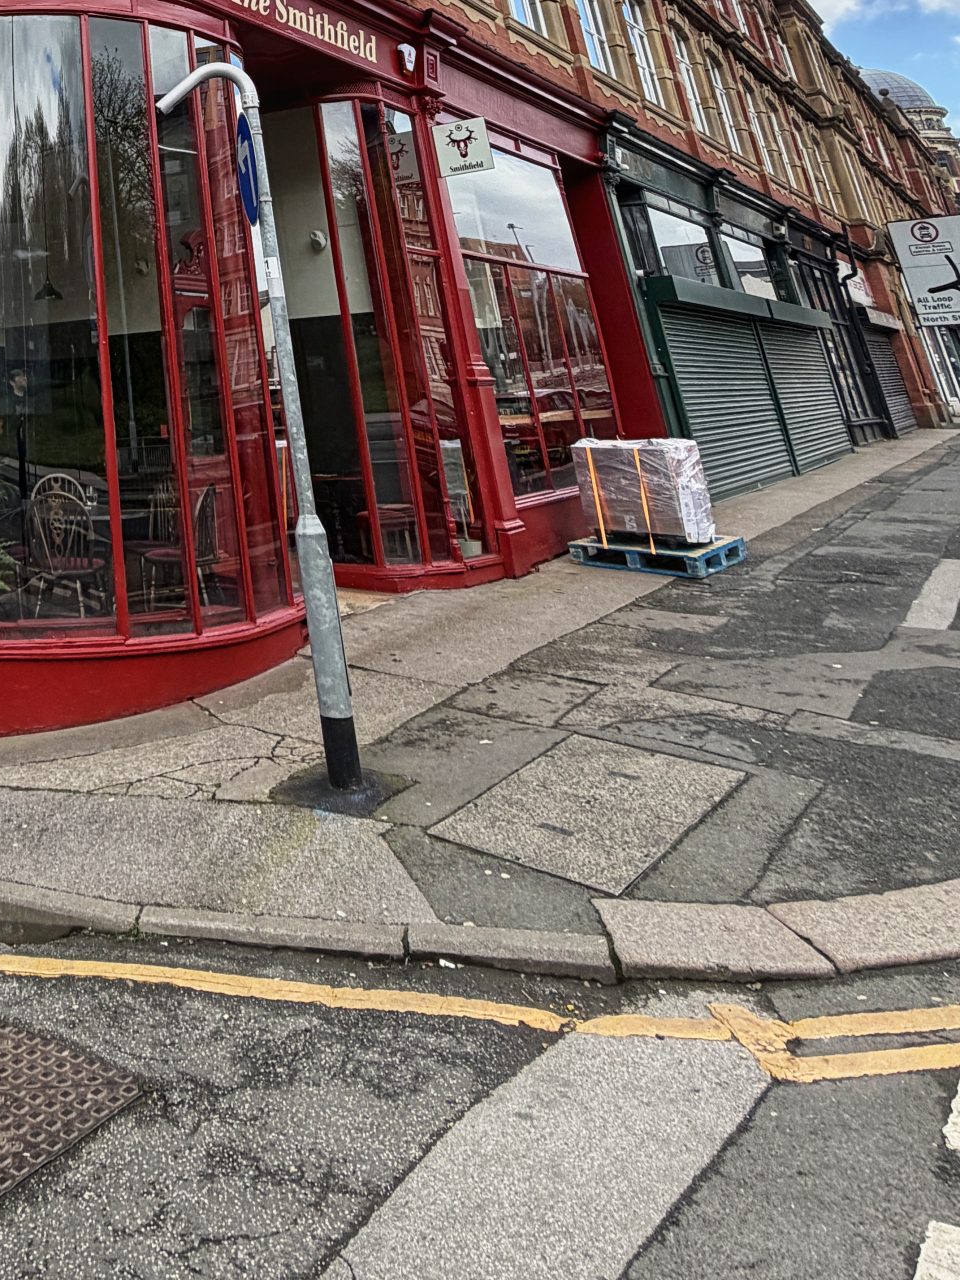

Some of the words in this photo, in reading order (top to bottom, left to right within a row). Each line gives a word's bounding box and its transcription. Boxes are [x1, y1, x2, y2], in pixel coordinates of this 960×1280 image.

[449, 160, 484, 173] Smithfield
[922, 303, 953, 311] Traffic
[922, 315, 949, 323] North
